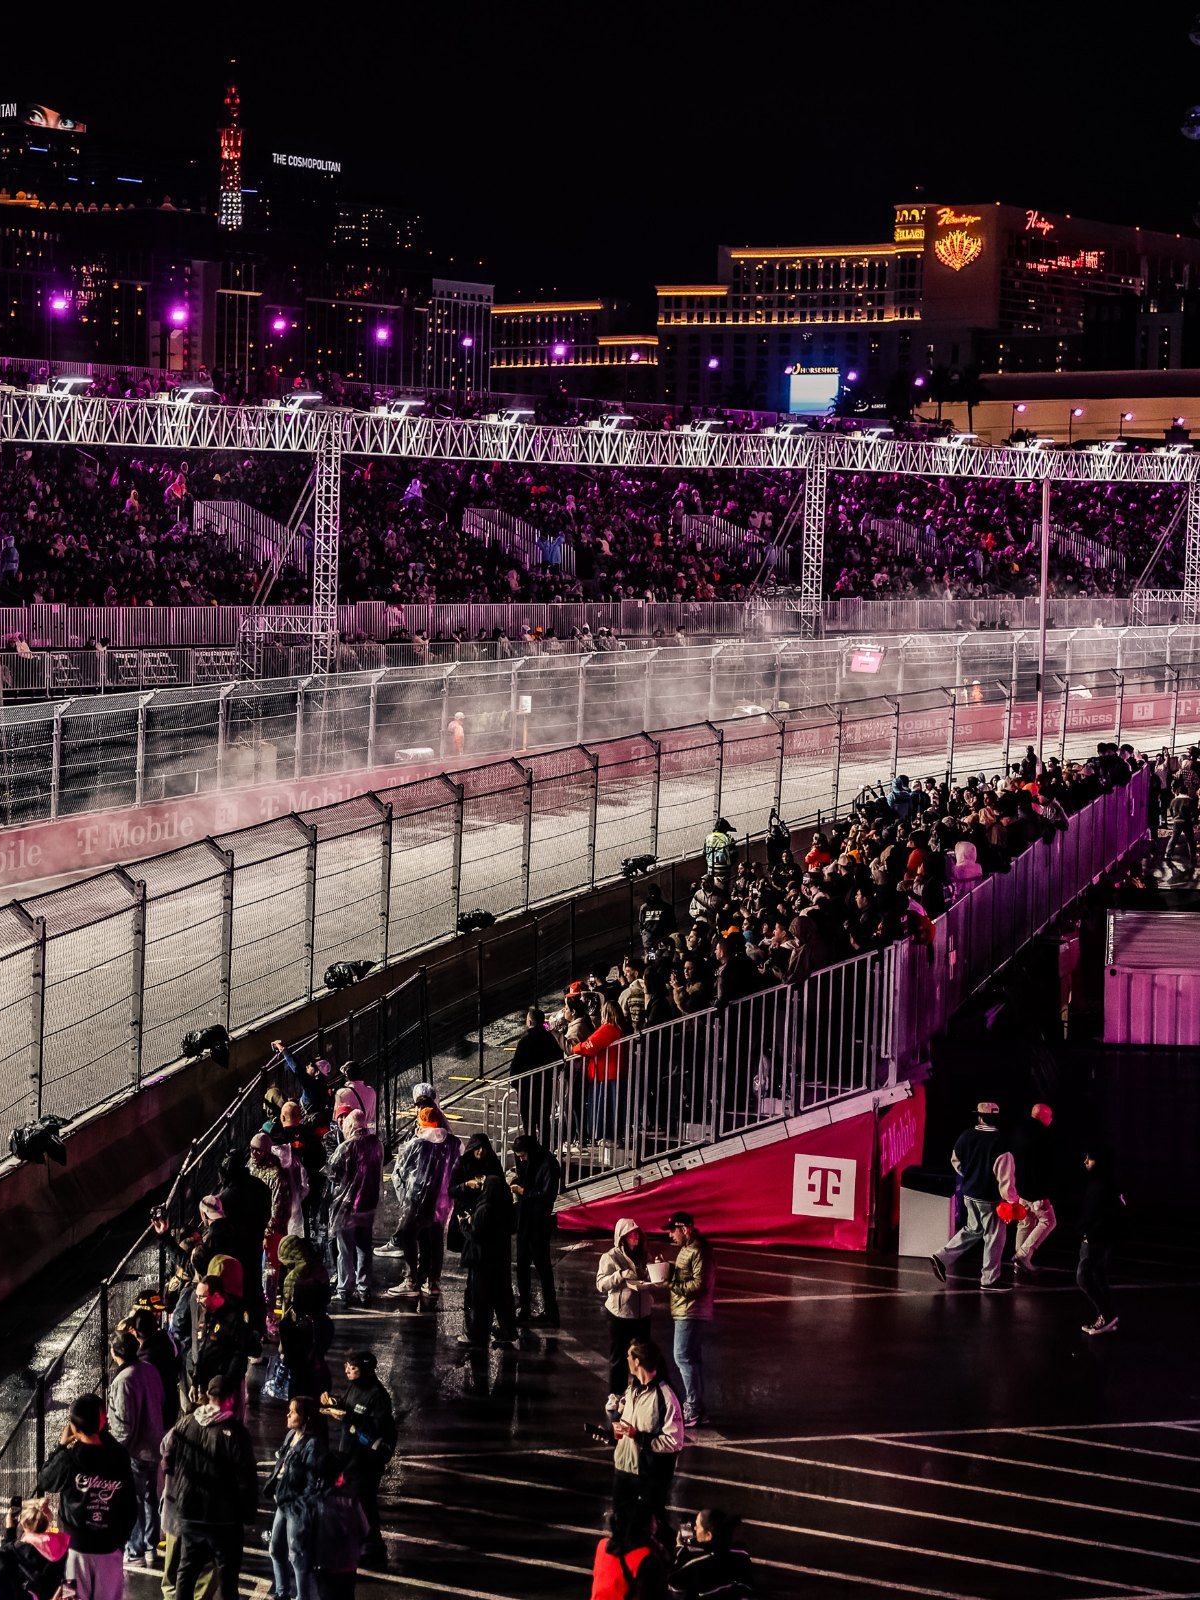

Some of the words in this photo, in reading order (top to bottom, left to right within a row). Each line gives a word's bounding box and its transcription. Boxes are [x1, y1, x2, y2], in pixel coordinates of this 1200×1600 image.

[272, 152, 287, 165] THE
[288, 155, 341, 173] COSMOPOLITAN
[107, 813, 194, 850] Mobile
[807, 1166, 842, 1207] T
